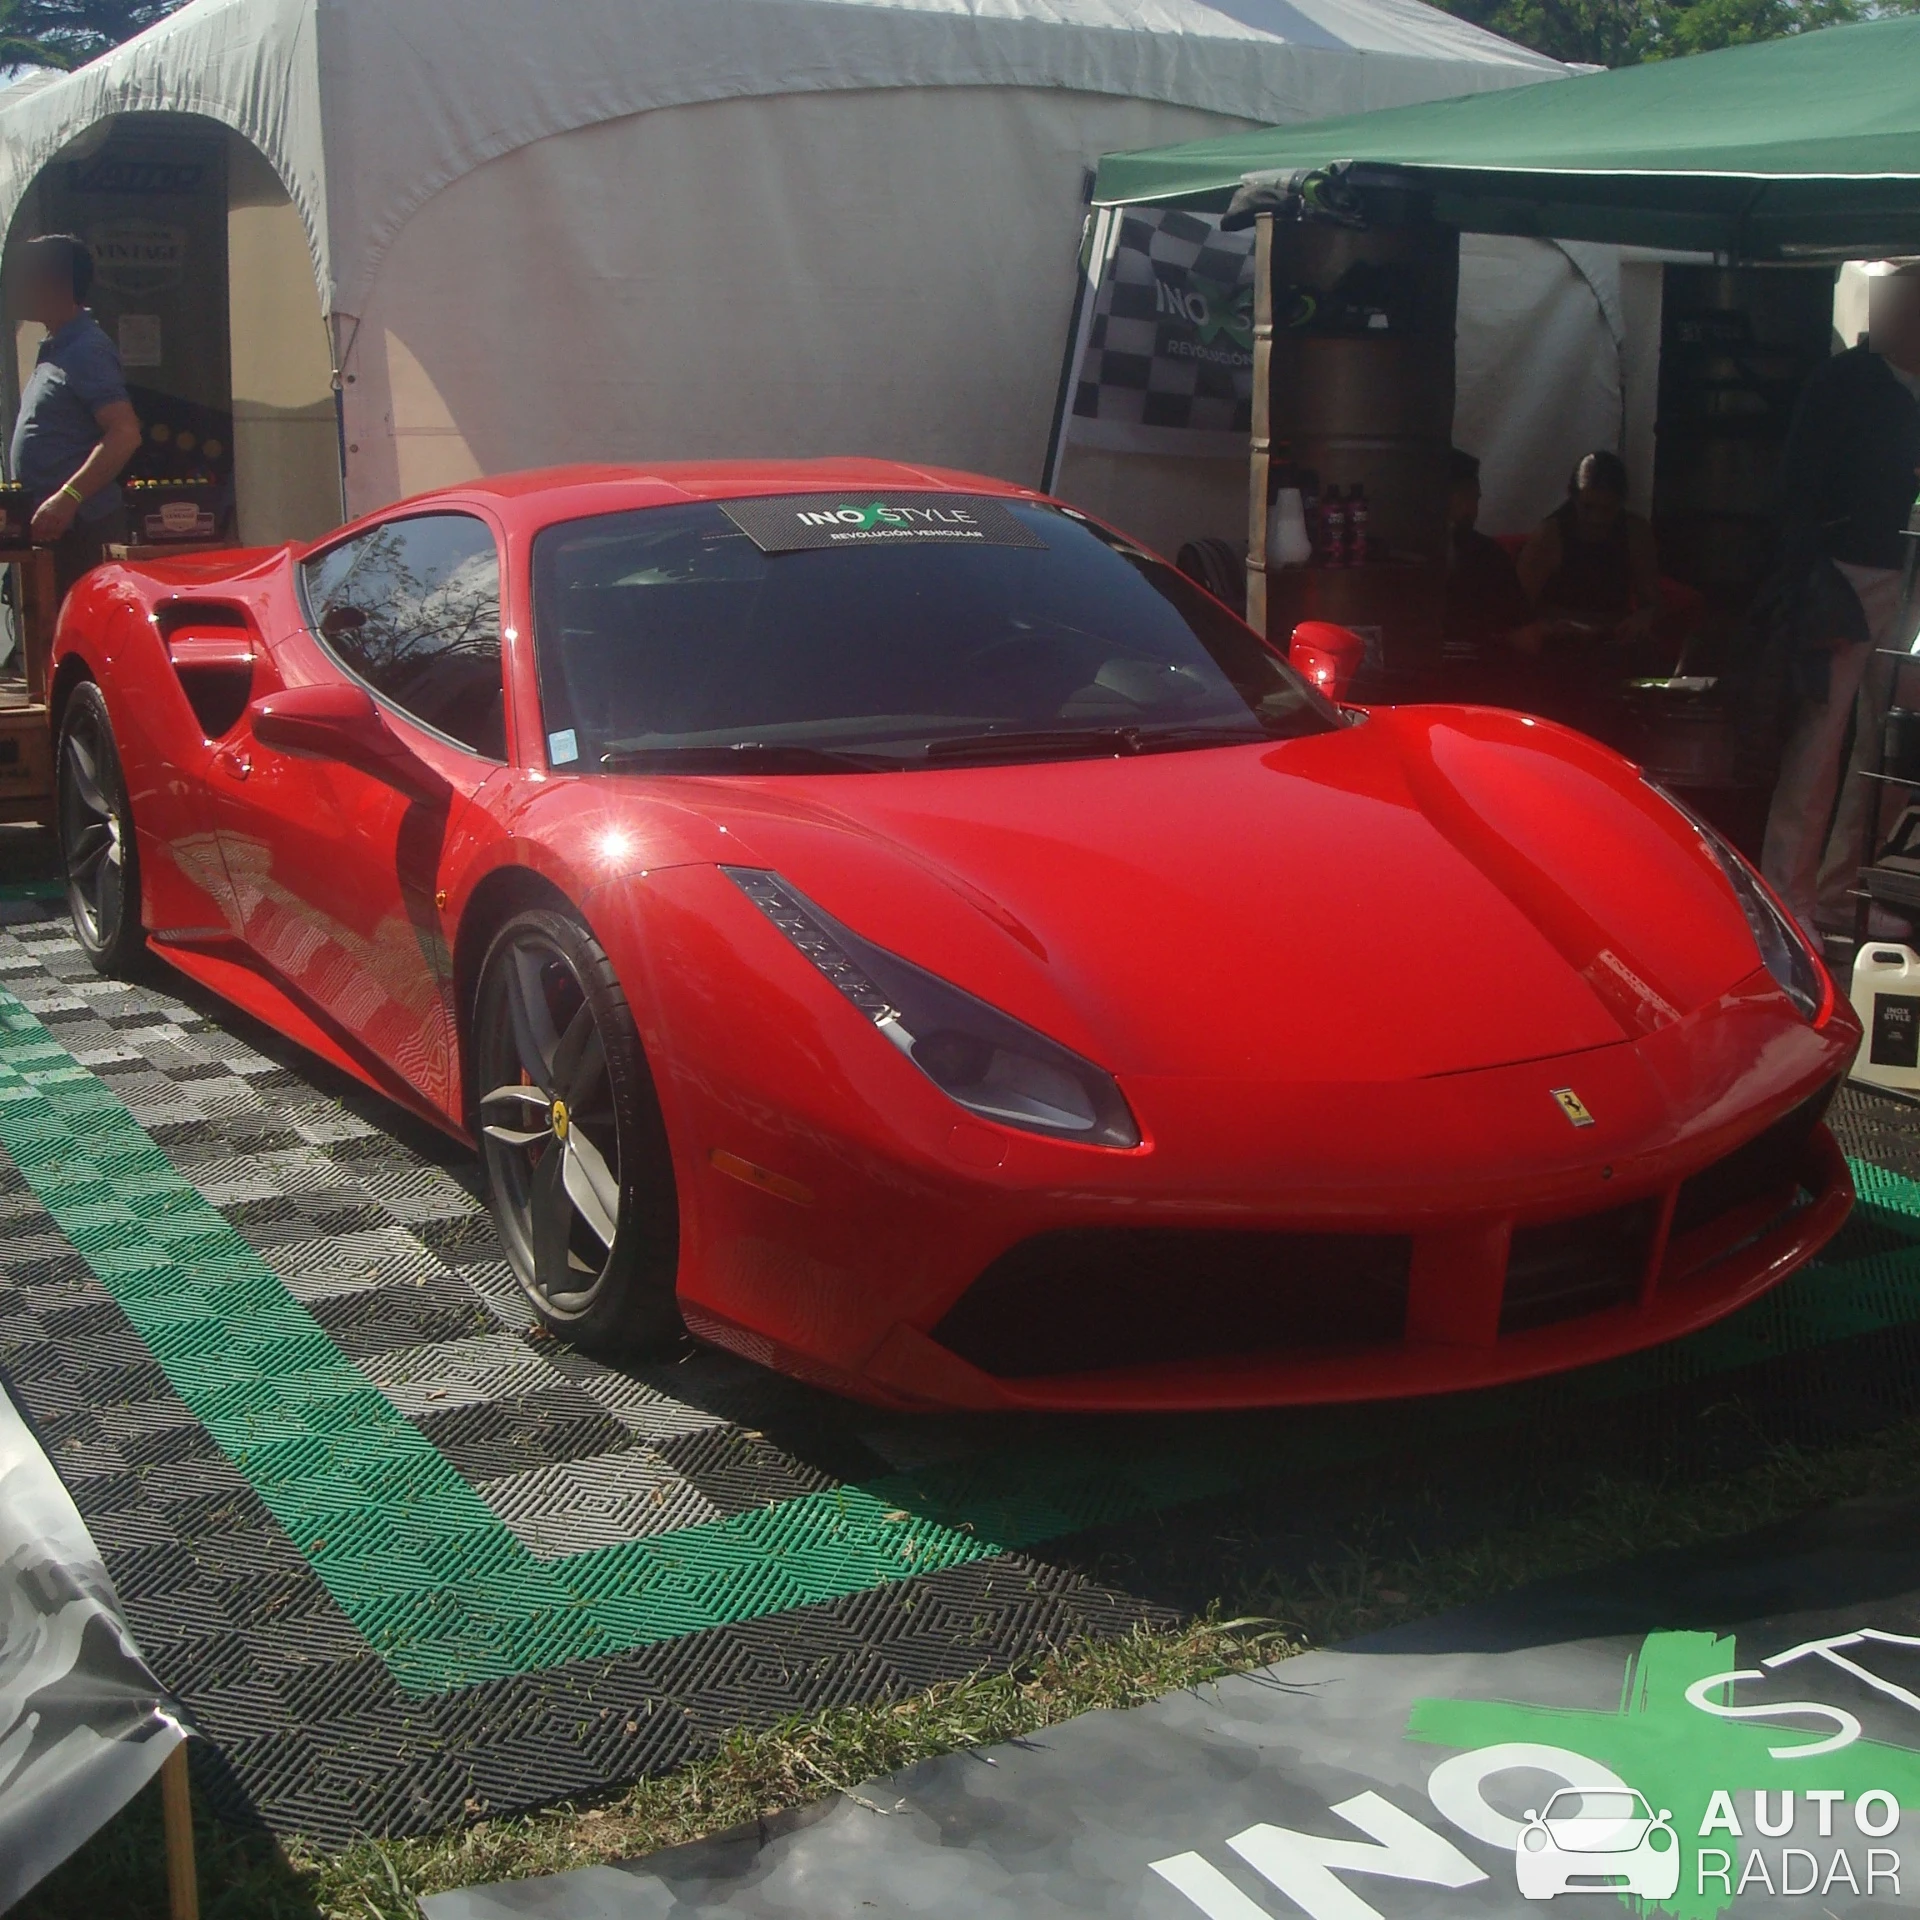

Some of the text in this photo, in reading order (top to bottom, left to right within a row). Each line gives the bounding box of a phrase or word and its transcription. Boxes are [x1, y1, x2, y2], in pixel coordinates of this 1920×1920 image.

[830, 528, 984, 540] REVOLUCIÓN VEHICULAR
[1886, 1006, 1909, 1015] INOX
[1884, 1013, 1911, 1022] STYLE
